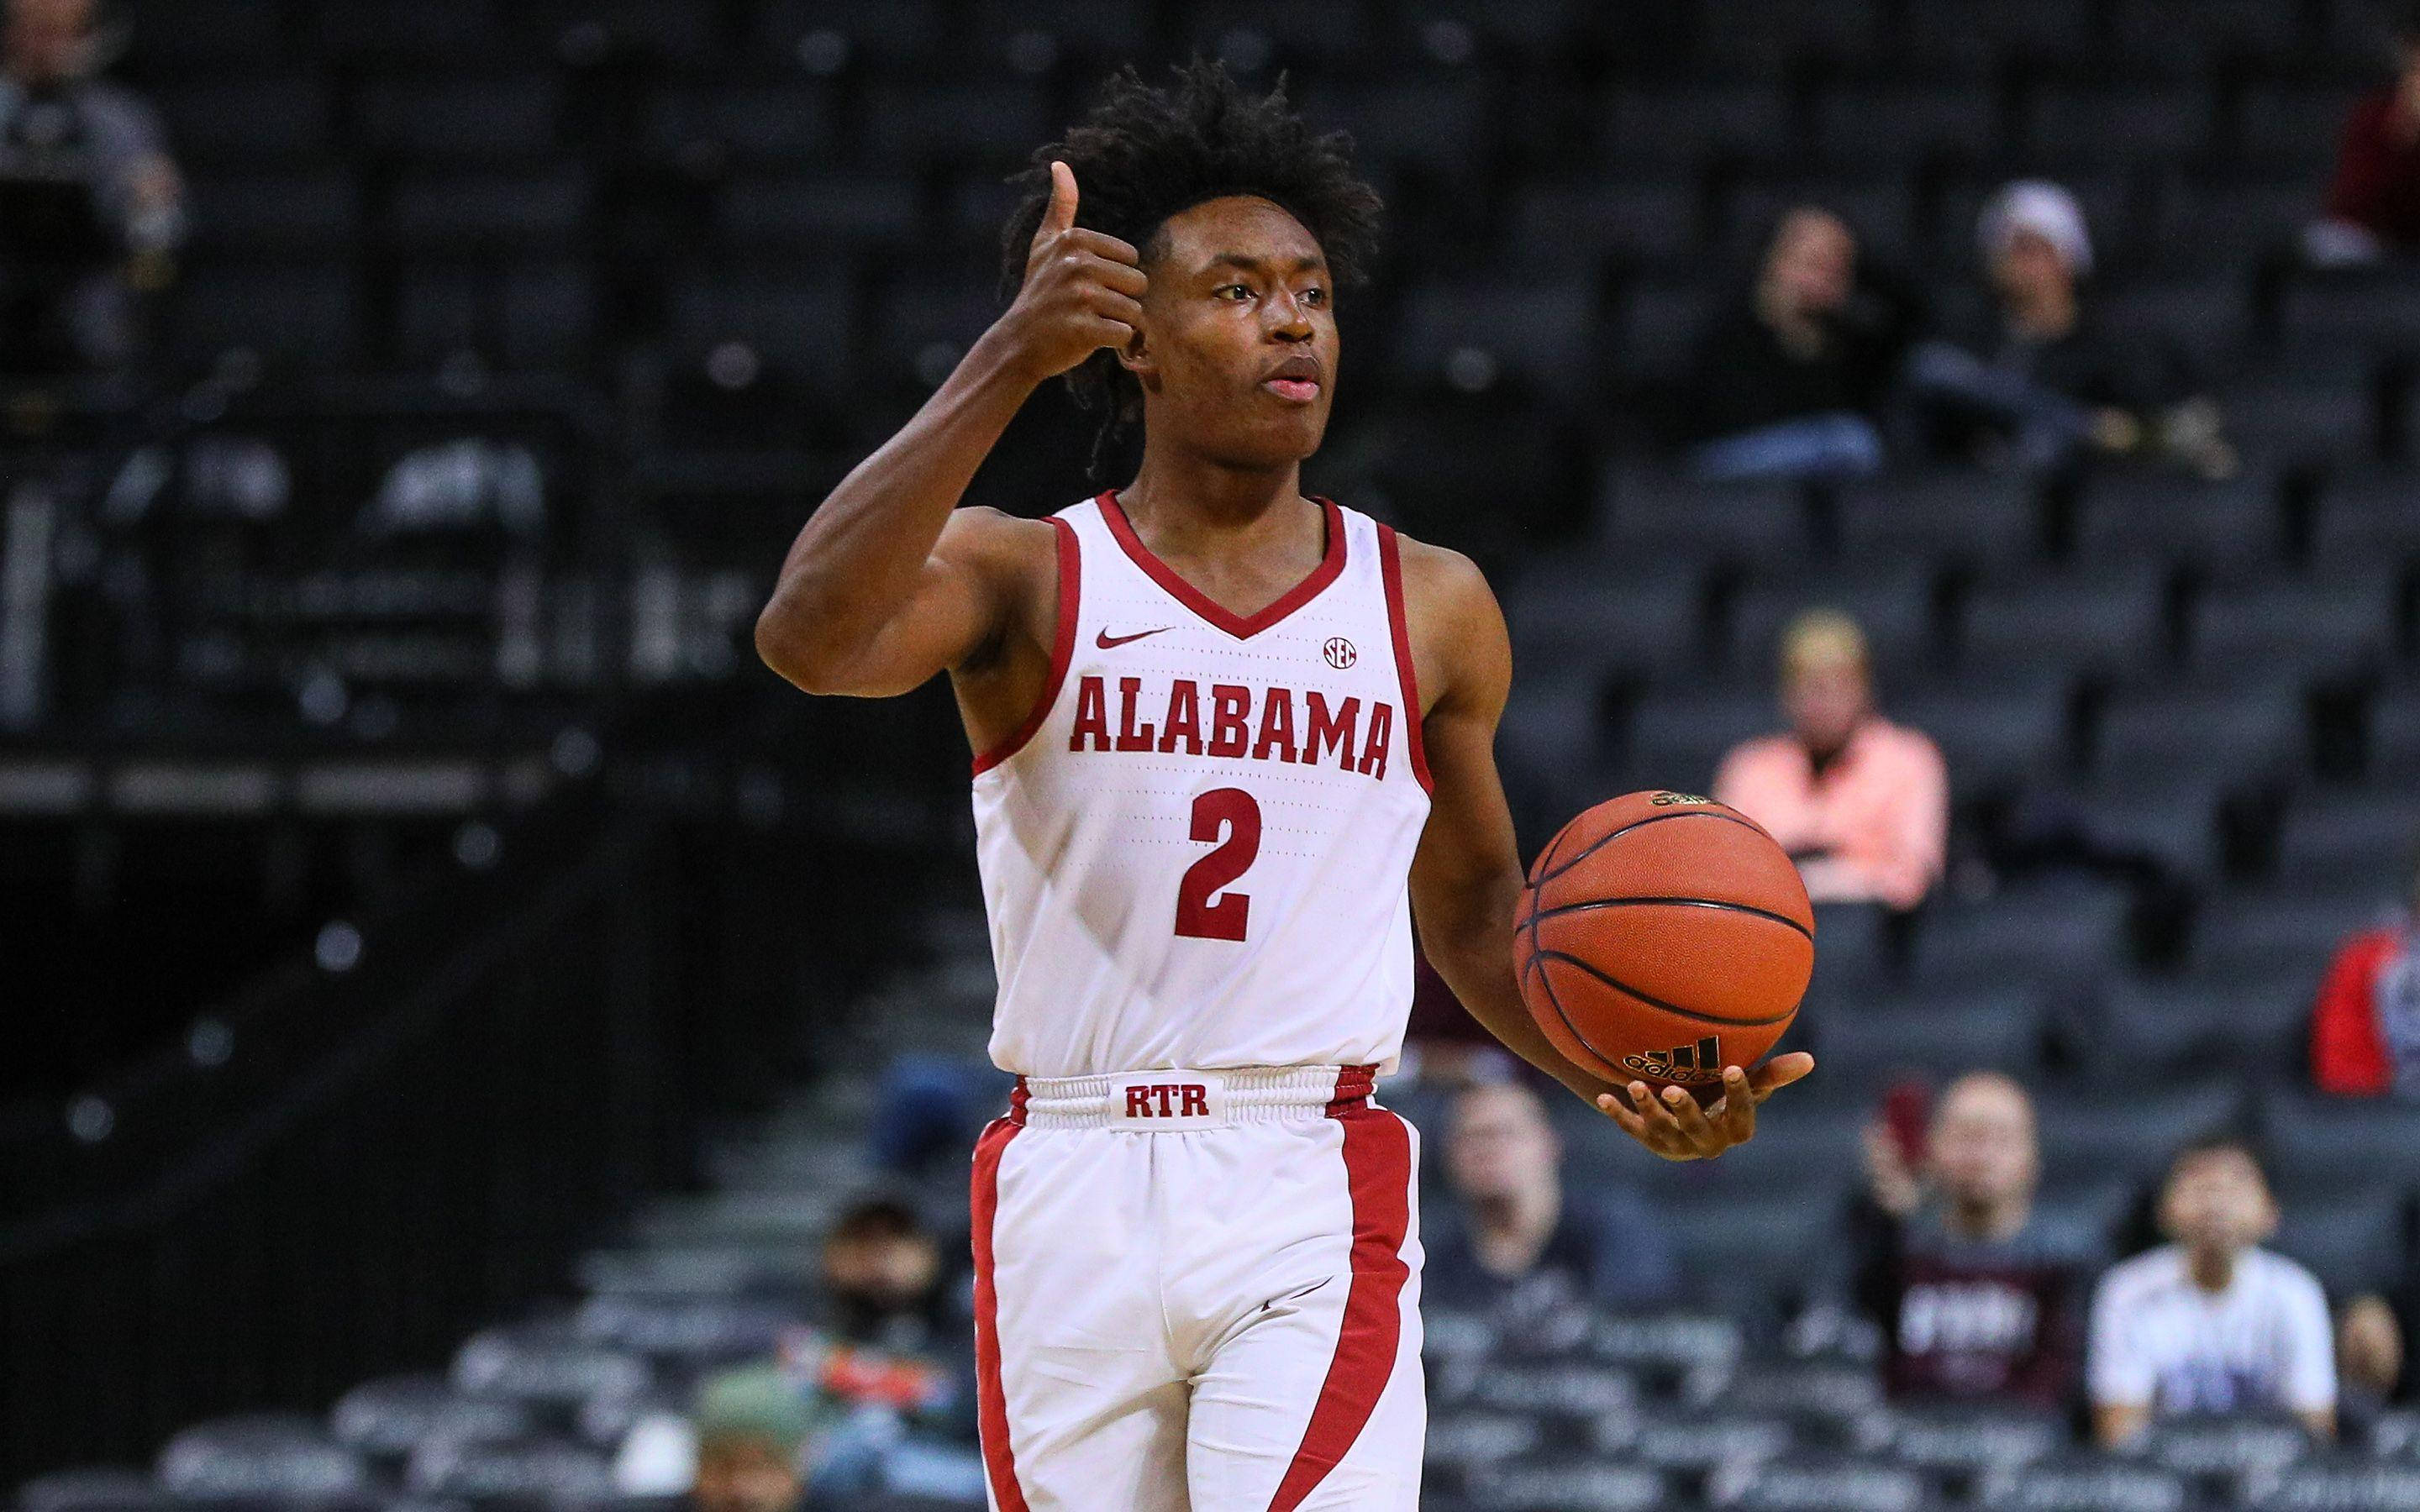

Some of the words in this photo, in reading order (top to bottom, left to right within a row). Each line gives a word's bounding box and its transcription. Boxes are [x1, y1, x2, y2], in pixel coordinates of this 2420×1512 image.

[1323, 638, 1357, 669] SEC
[1070, 676, 1392, 781] ALABAMA
[1175, 788, 1262, 942] 2
[1125, 1084, 1210, 1118] RTR
